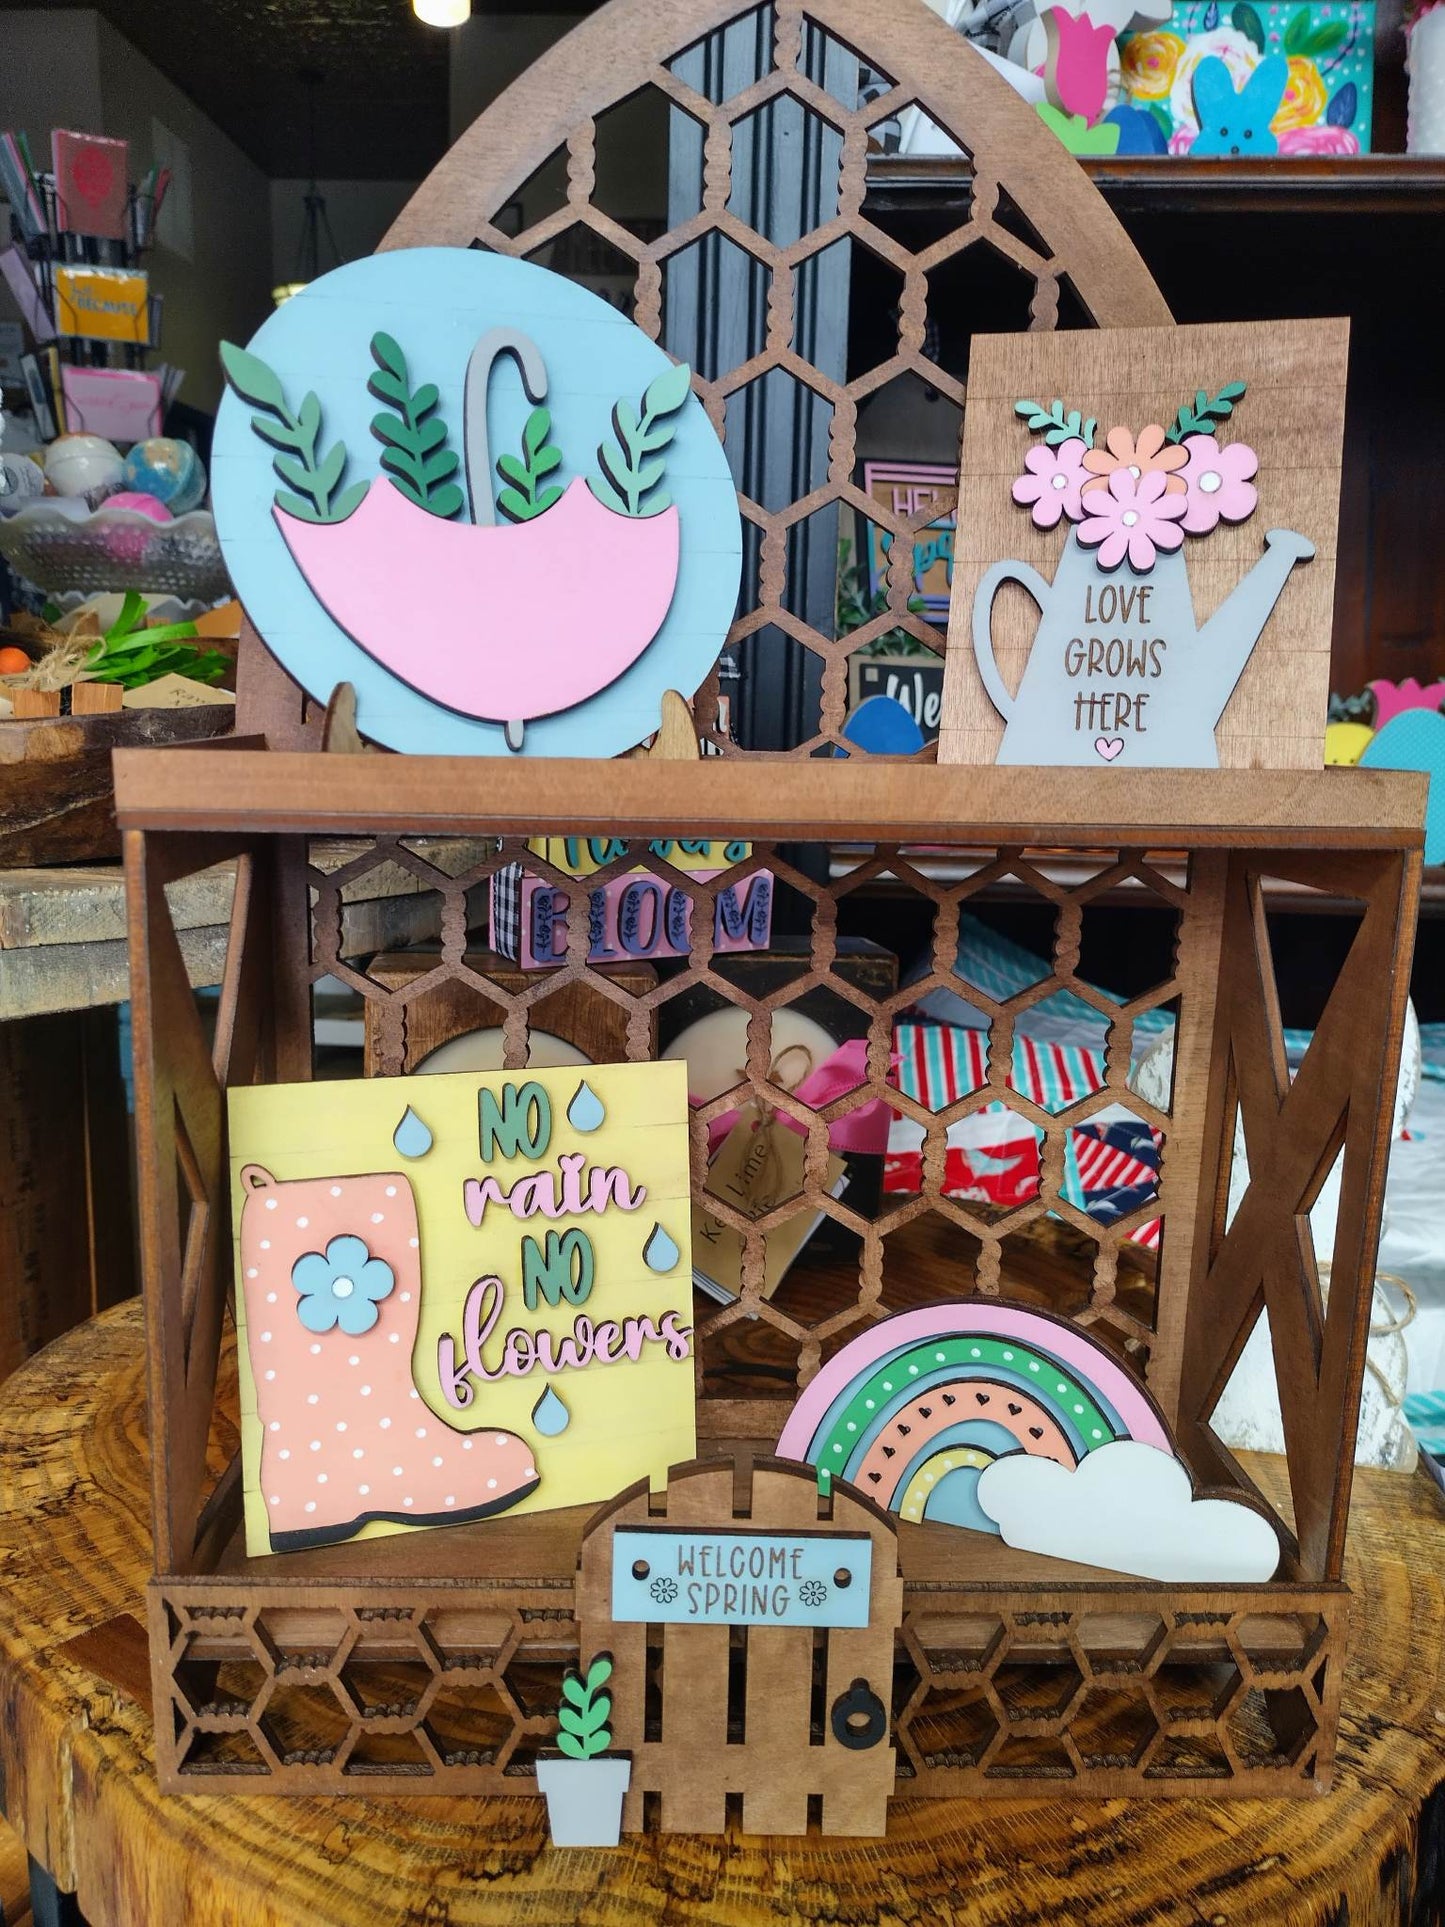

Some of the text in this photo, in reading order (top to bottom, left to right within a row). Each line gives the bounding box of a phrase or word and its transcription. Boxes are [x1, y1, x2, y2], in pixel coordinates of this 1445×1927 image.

[1084, 584, 1154, 624] LOVE
[1064, 637, 1167, 678] GROWS
[1073, 691, 1151, 732] HERE
[530, 876, 772, 963] BLOOM
[478, 1081, 552, 1163] NO
[463, 1152, 647, 1228] rain
[725, 1143, 768, 1198] Lime
[521, 1227, 595, 1311] NO
[437, 1274, 694, 1409] flowers
[677, 1544, 805, 1580] WELCOME
[687, 1582, 791, 1617] SPRING
